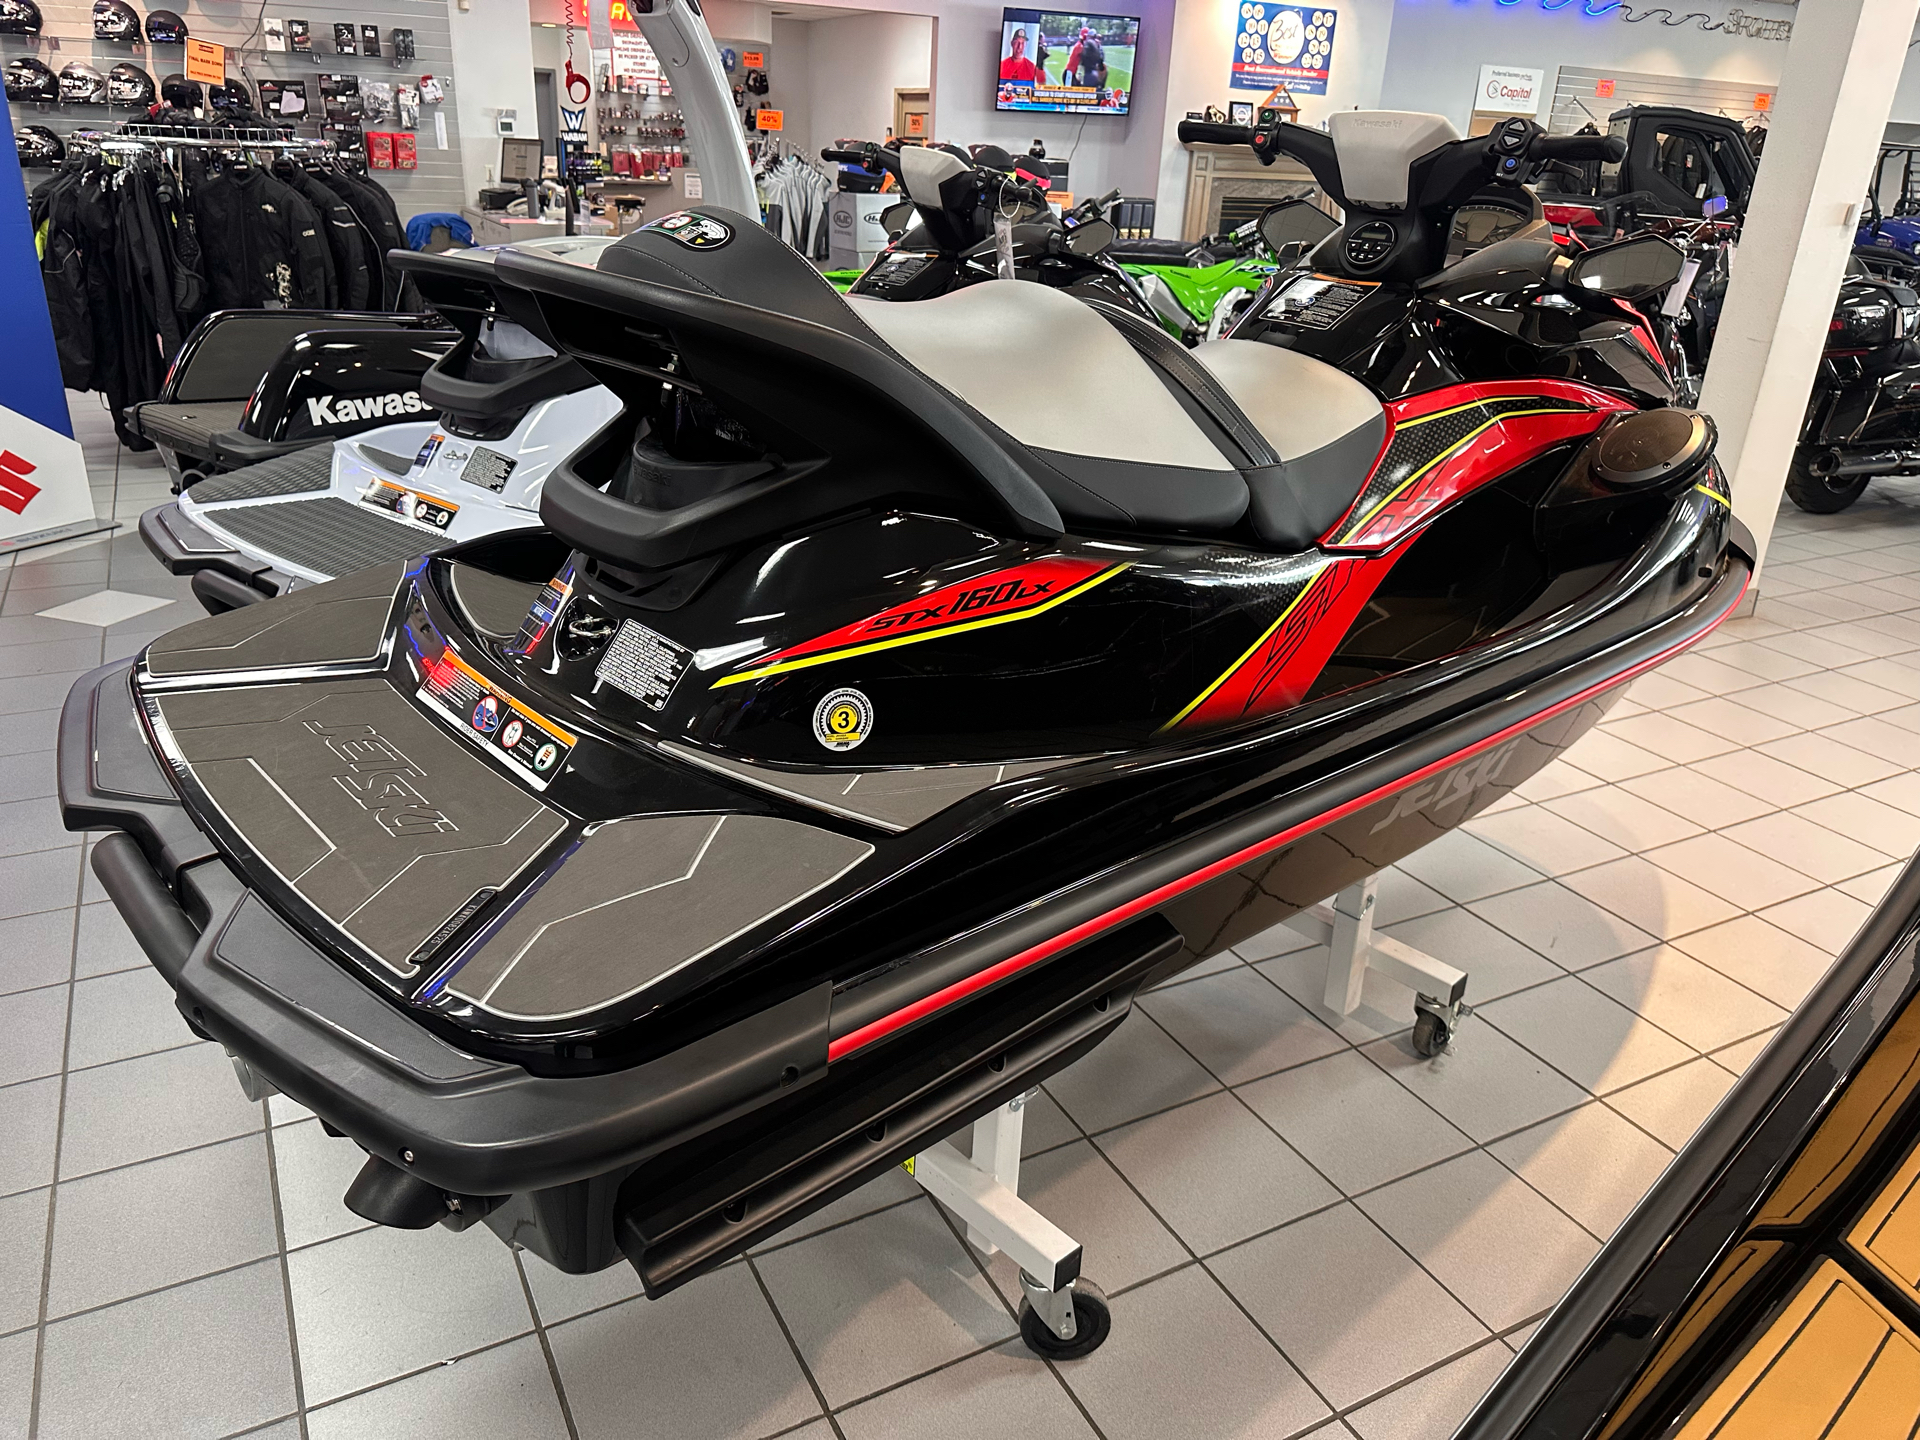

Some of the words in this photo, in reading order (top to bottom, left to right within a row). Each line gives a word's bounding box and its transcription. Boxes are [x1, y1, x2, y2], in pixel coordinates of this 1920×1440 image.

[1500, 85, 1532, 100] Capital
[1353, 119, 1403, 129] Kawasaki
[838, 711, 849, 729] 3
[460, 722, 474, 737] RIDER
[472, 732, 490, 747] SAFETY
